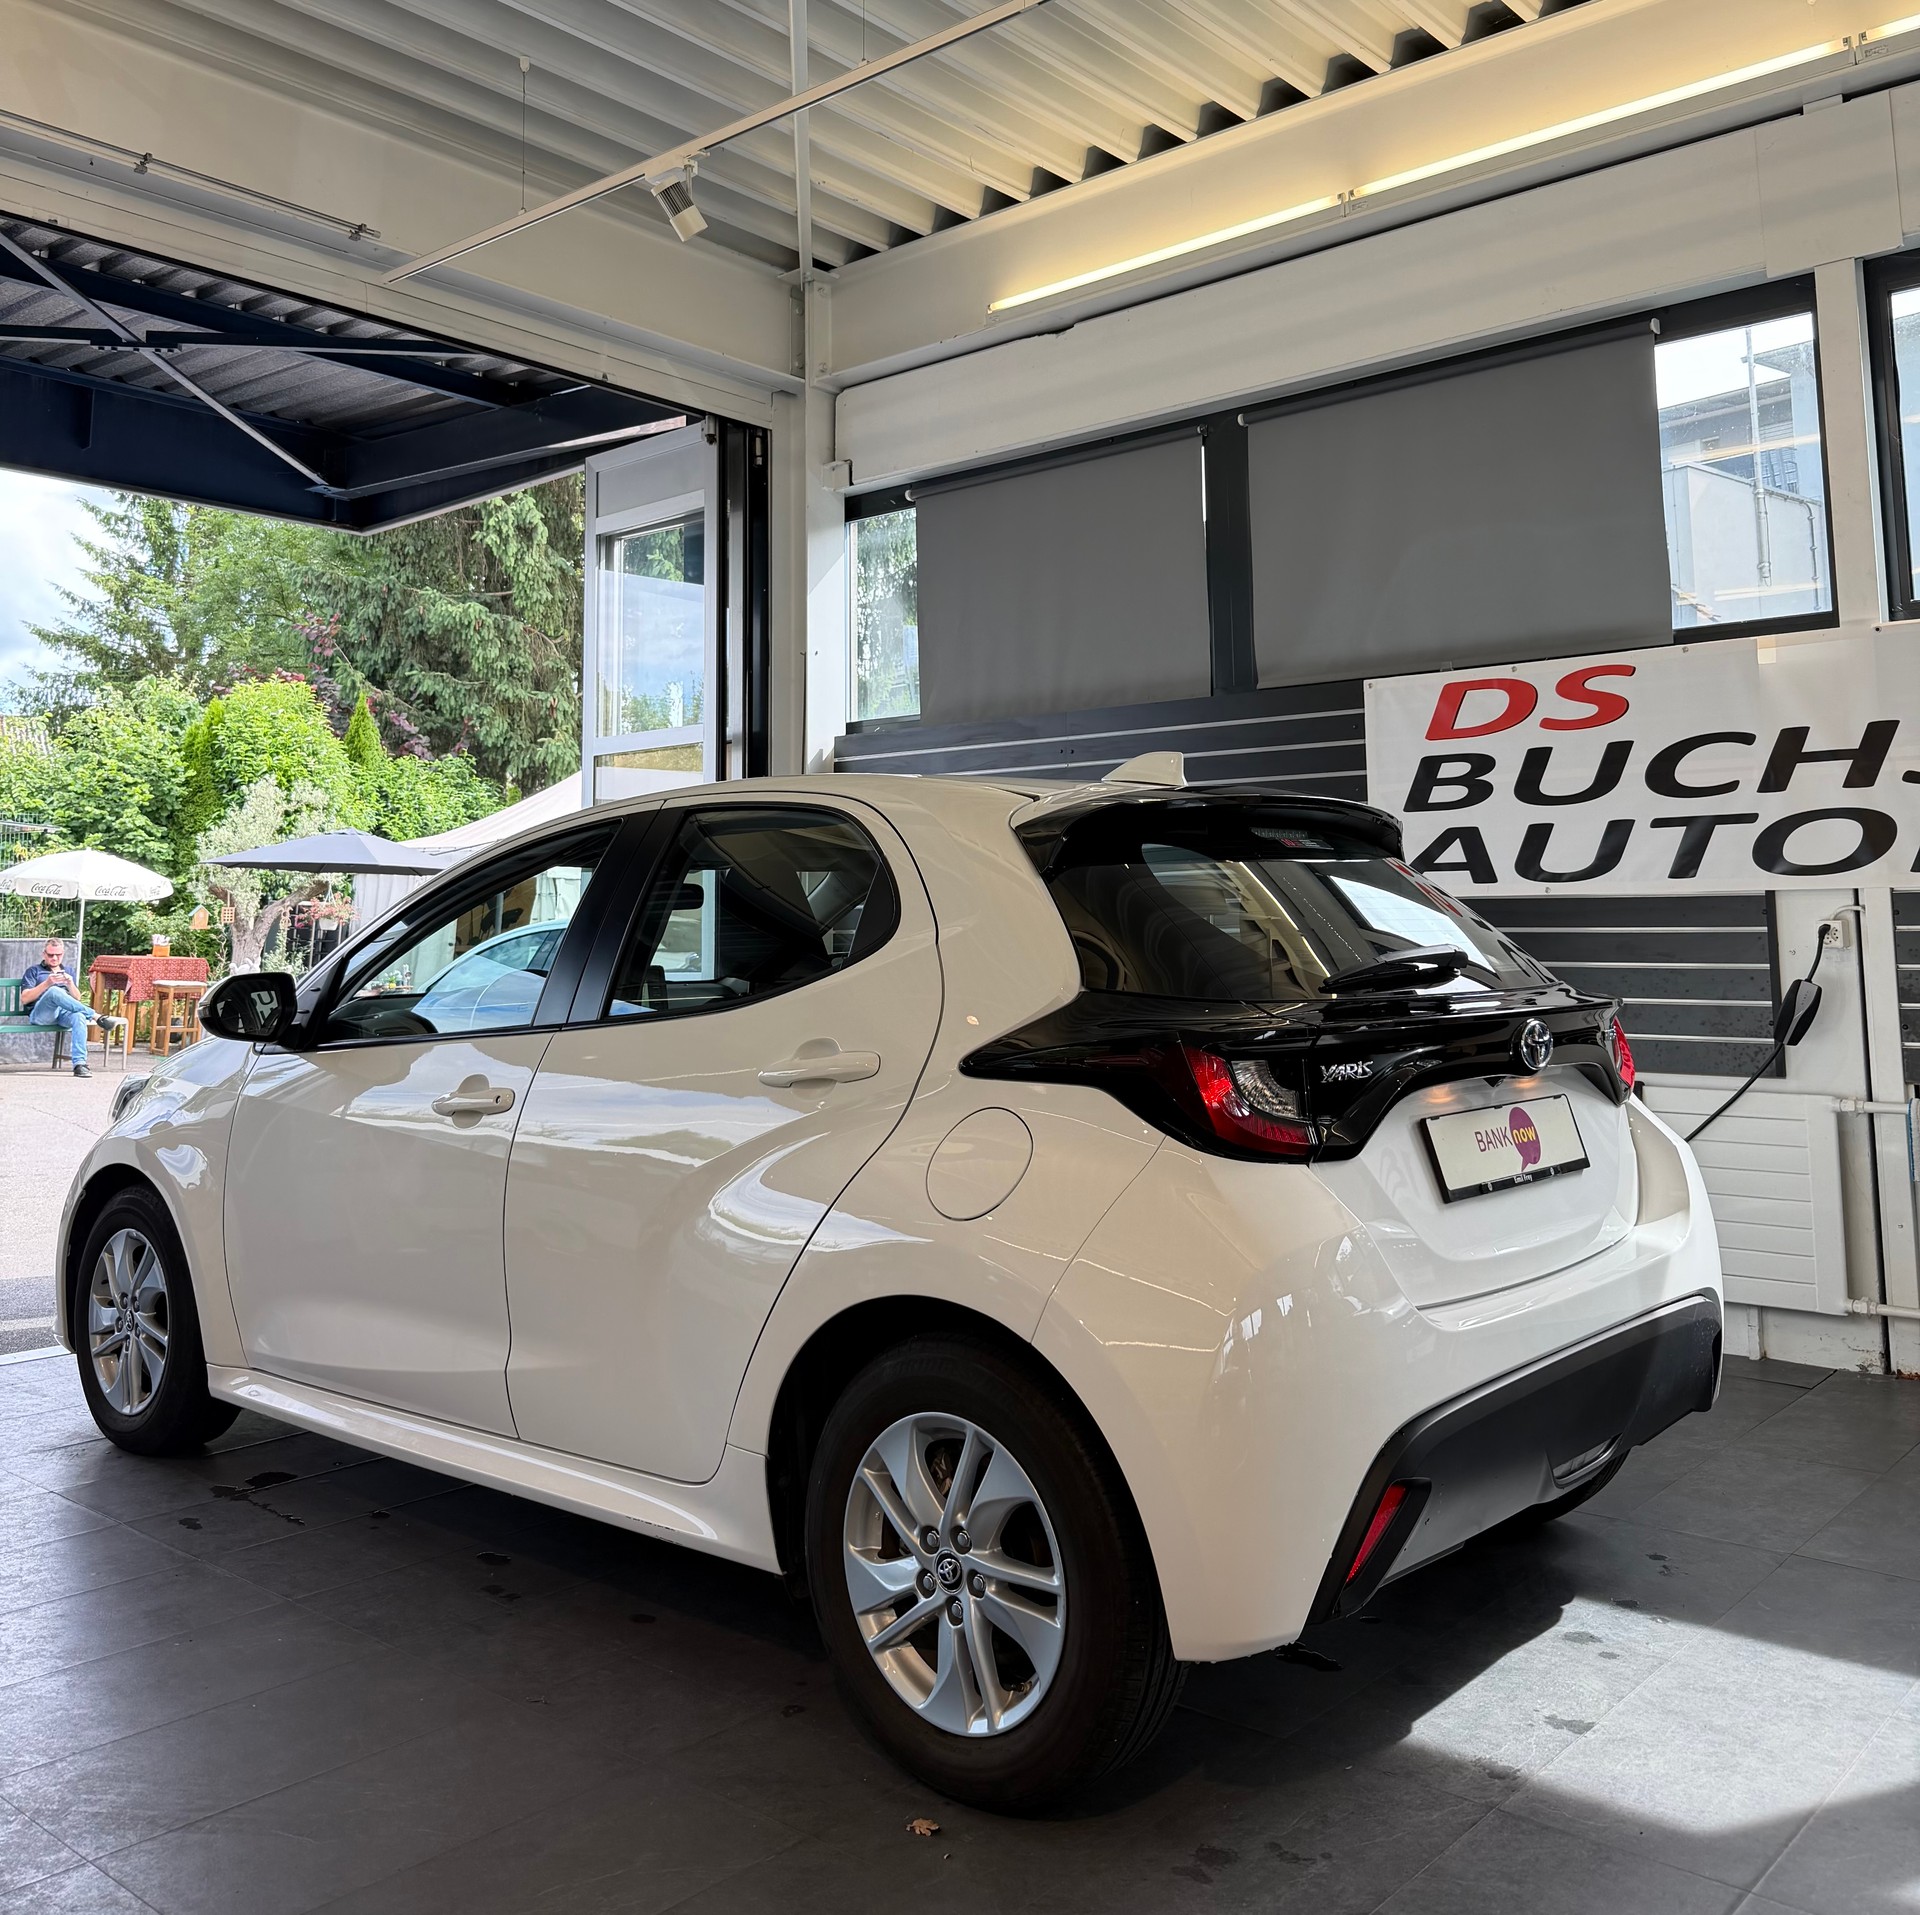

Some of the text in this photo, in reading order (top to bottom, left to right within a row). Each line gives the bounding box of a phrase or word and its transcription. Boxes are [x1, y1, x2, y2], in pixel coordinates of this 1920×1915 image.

[1425, 664, 1636, 741] DS
[1403, 719, 1920, 812] BUCH
[1412, 807, 1920, 884] AUTO
[1320, 1061, 1374, 1083] YARIS
[1475, 1126, 1537, 1153] BANK now
